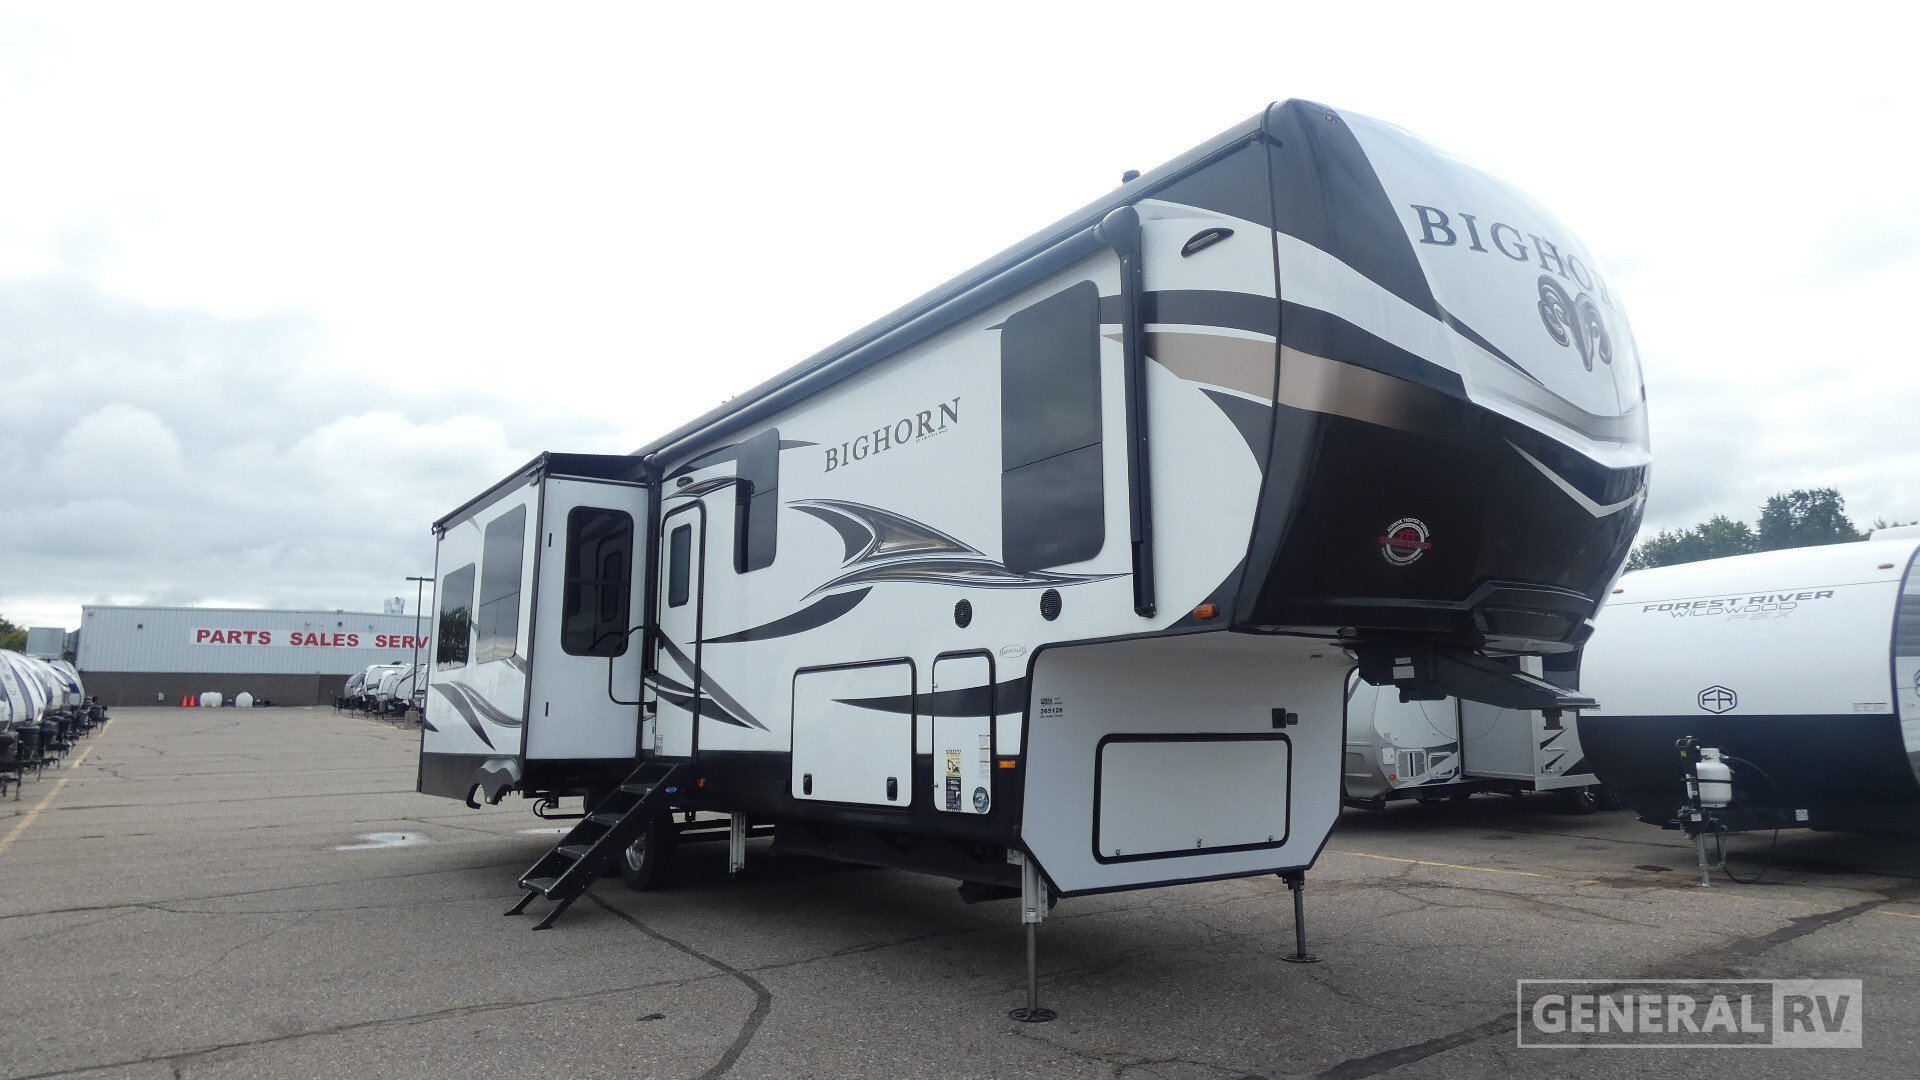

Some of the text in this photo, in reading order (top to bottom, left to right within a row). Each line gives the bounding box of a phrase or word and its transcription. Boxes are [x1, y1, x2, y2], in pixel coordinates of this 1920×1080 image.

[1410, 204, 1619, 315] BIGHOR
[824, 396, 961, 473] BIGHORN
[1642, 590, 1835, 613] FOREST RIVER
[196, 629, 430, 649] PARTS SALES SERV
